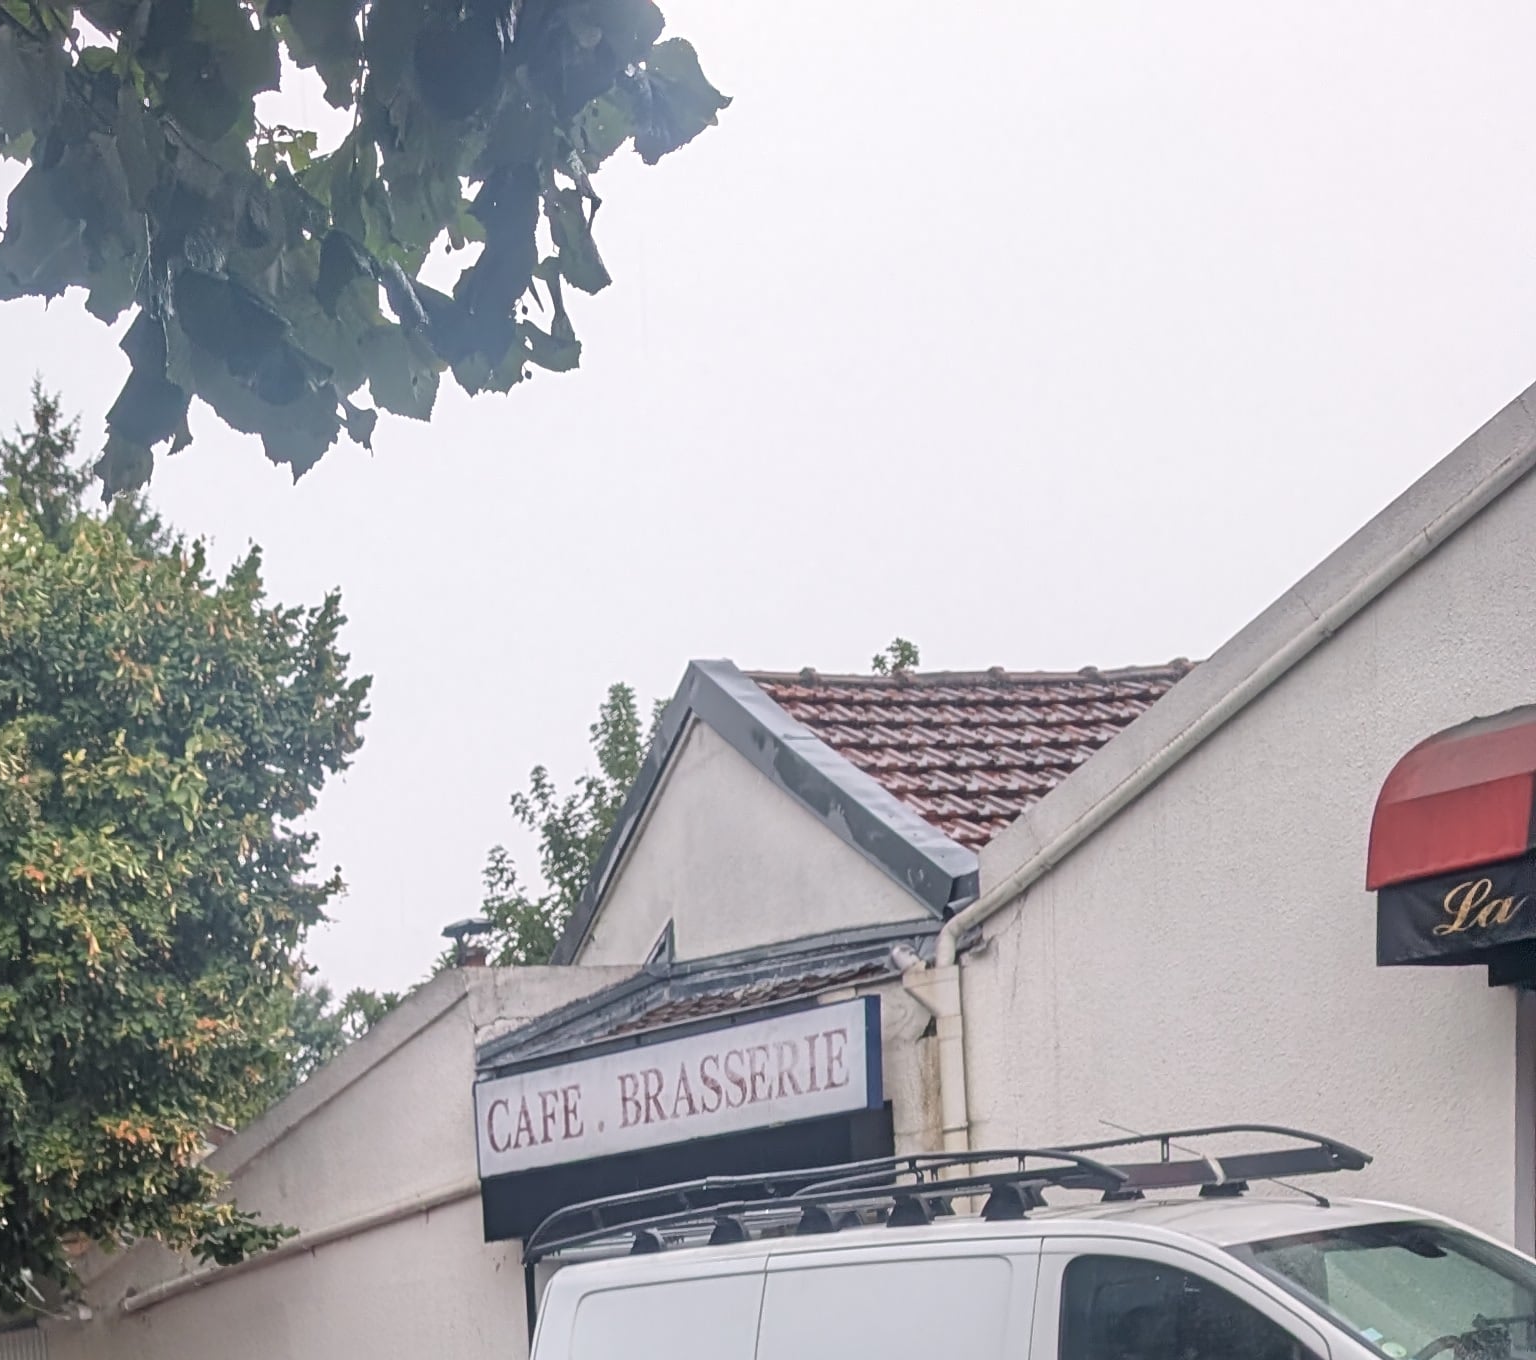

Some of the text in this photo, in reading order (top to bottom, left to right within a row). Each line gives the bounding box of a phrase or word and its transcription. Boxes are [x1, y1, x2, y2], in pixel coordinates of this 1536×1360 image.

[1432, 878, 1528, 937] La
[486, 1083, 585, 1153] CAFE
[617, 1027, 851, 1130] BRASSERIE
